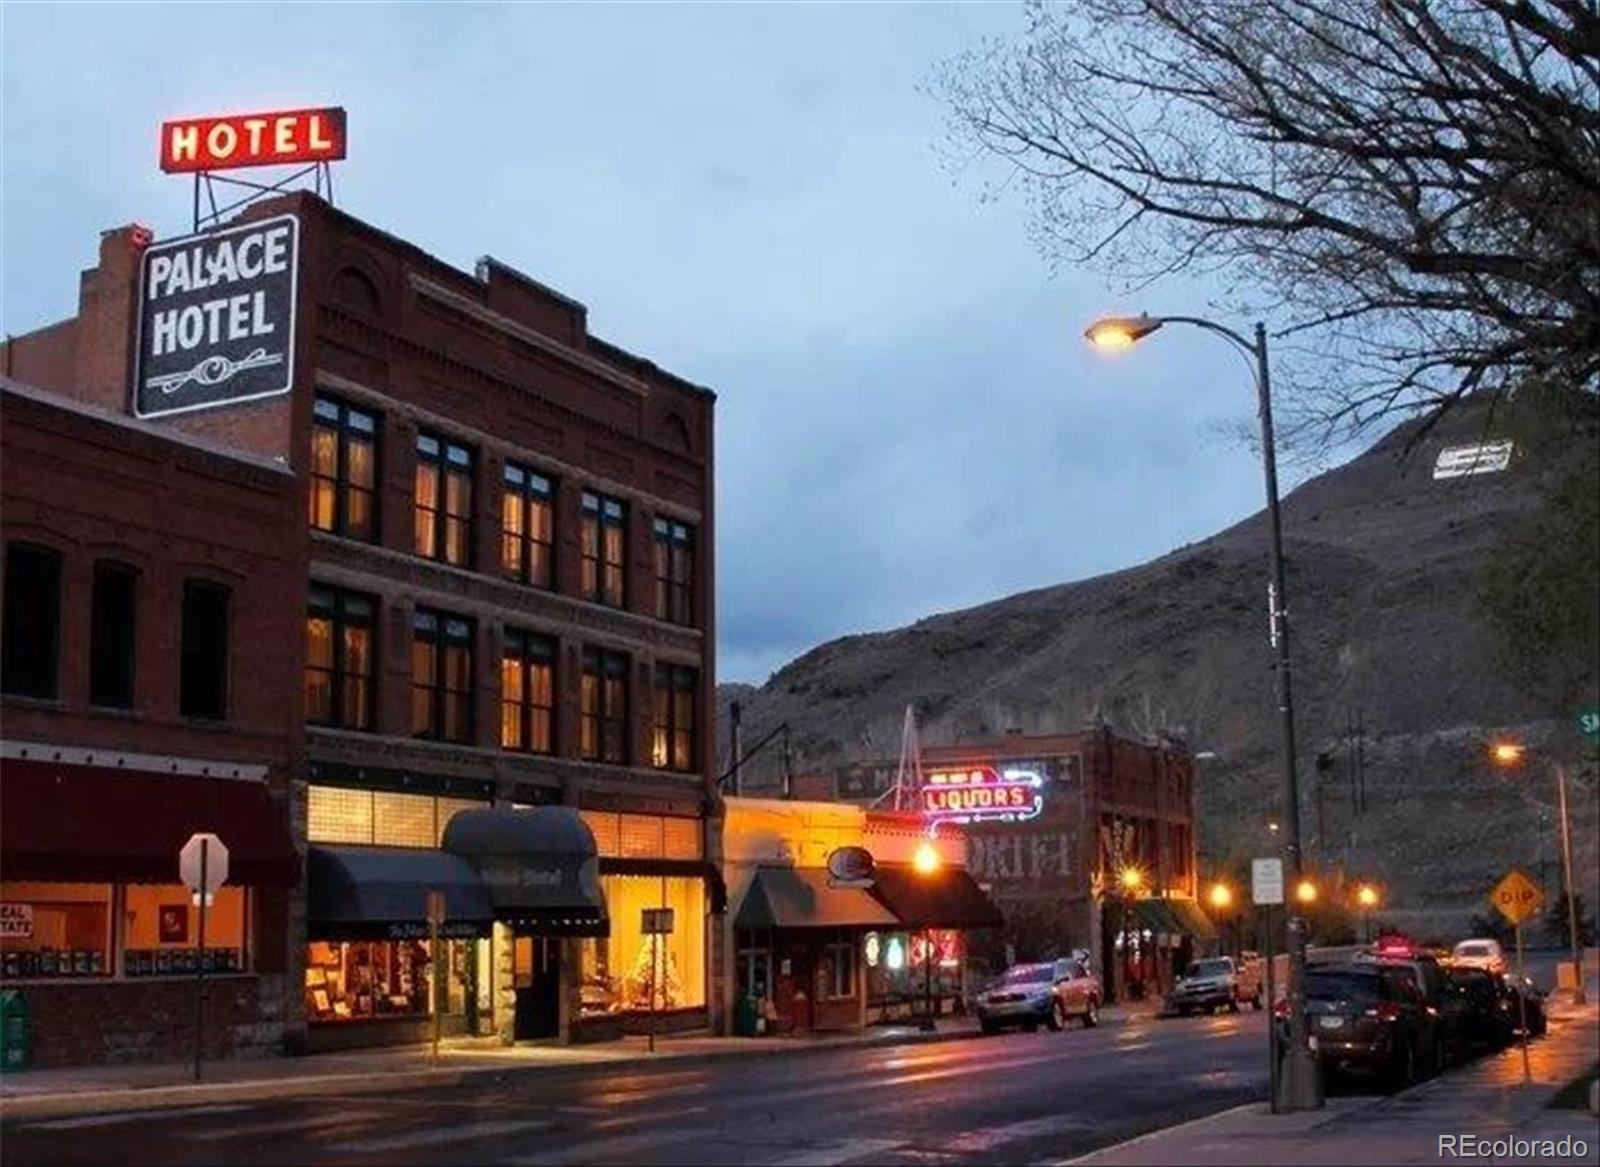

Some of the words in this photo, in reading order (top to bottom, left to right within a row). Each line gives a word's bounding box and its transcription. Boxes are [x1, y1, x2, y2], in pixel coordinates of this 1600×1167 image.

[171, 115, 333, 162] HOTEL
[149, 227, 289, 300] PALACE
[152, 290, 275, 356] HOTEL
[926, 786, 1025, 811] LIQUORS
[1500, 890, 1534, 904] DIP
